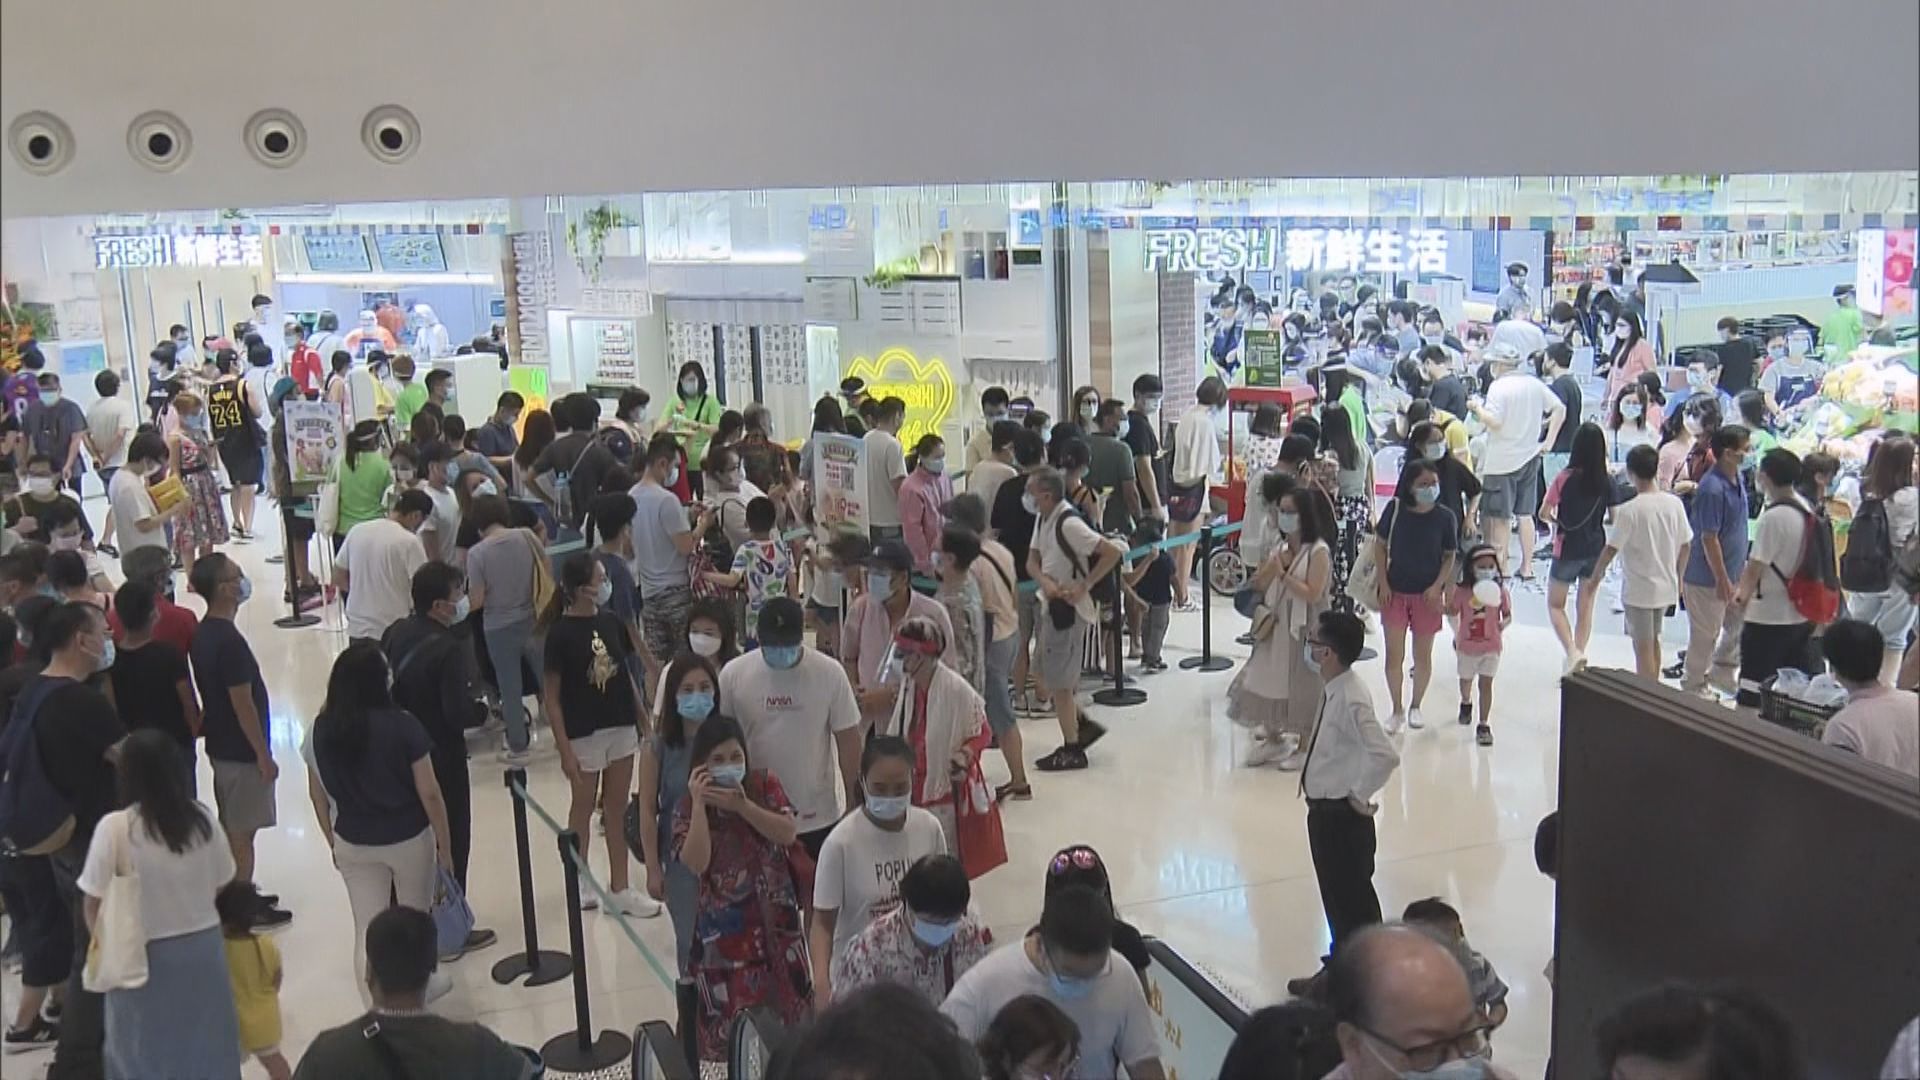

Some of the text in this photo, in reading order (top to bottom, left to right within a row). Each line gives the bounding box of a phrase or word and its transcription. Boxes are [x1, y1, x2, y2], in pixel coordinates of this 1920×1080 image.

[95, 237, 173, 269] FRESH
[1144, 228, 1449, 273] FRESH 新鮮生活
[210, 401, 242, 428] 24
[766, 695, 792, 706] NASA
